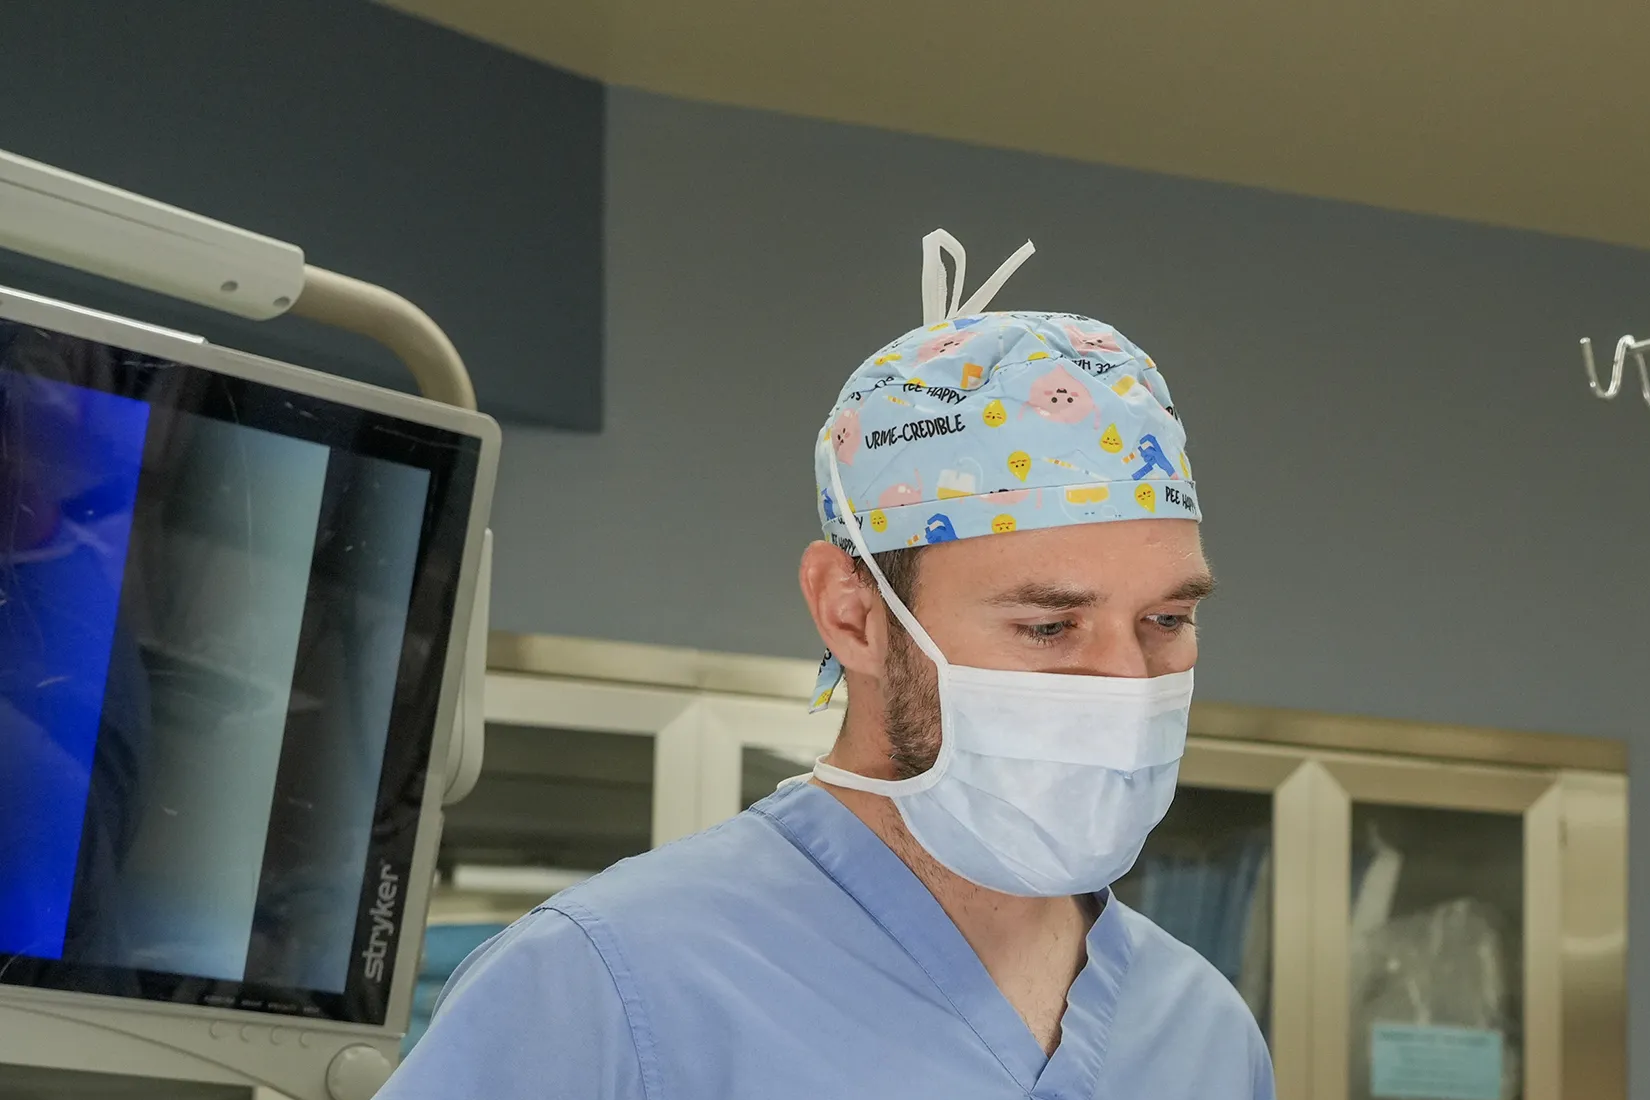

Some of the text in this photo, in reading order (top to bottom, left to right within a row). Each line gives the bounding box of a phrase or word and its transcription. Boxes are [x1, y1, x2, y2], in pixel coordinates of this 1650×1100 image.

[927, 386, 967, 405] HAPPY
[1165, 485, 1181, 505] PEE
[362, 864, 400, 983] stryker
